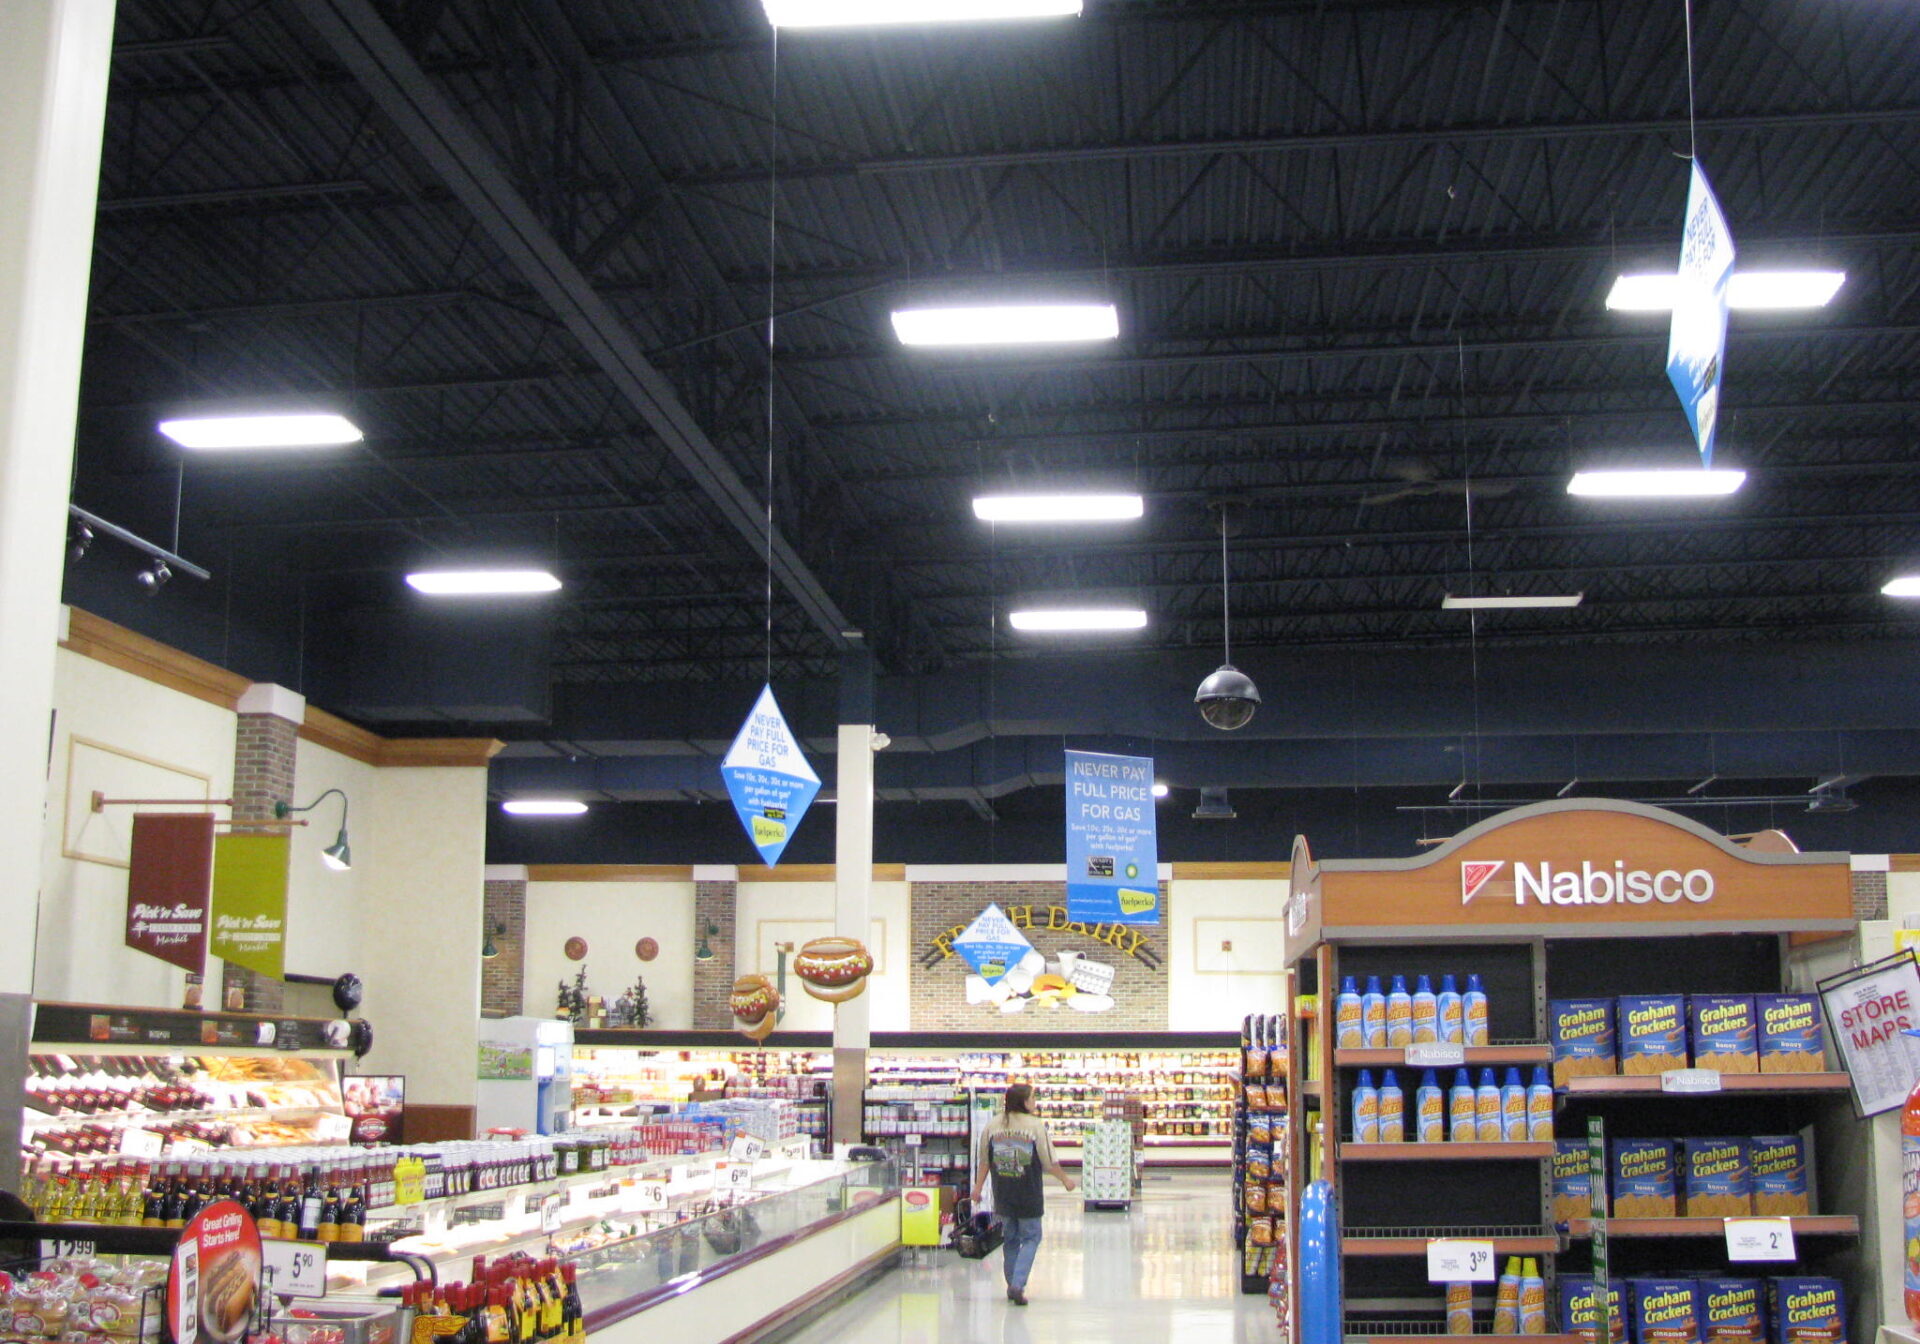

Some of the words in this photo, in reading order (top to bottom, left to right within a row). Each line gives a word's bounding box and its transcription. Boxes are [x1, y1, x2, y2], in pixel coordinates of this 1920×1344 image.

[755, 712, 781, 728] NEVER
[750, 725, 764, 738] PAY
[766, 728, 786, 743] FULL
[747, 737, 769, 752] PRICE
[772, 743, 789, 757] FOR
[759, 754, 776, 768] GAS
[1074, 761, 1118, 778] NEVER
[1122, 766, 1146, 780] PAY
[1074, 782, 1107, 798] FULL
[1110, 785, 1148, 801] PRICE
[1082, 803, 1110, 819] FOR
[1114, 806, 1141, 821] GAS
[1514, 860, 1715, 905] Nabisco
[1559, 1007, 1605, 1027] Graham
[1628, 1004, 1676, 1024] Graham
[1700, 1003, 1747, 1022] Graham
[1764, 1002, 1812, 1022] Graham
[1841, 990, 1910, 1028] STORE
[1560, 1021, 1606, 1040] Crackers
[1629, 1018, 1677, 1037] Crackers
[1701, 1017, 1748, 1036] Crackers
[1766, 1016, 1813, 1035] Crackers
[1851, 1016, 1912, 1051] MAPS
[1419, 1049, 1461, 1060] Nabisco
[1573, 1046, 1595, 1054] honey
[1644, 1043, 1665, 1051] honey
[1715, 1041, 1737, 1050] honey
[1781, 1041, 1802, 1049] honey
[1676, 1075, 1718, 1086] Nabisco
[1553, 1148, 1590, 1166] Graha
[1620, 1147, 1666, 1166] Graham
[1692, 1145, 1739, 1165] Graham
[1553, 1162, 1590, 1178] Cracke
[1621, 1160, 1666, 1178] Crackers
[1693, 1159, 1739, 1177] Crackers
[203, 1216, 222, 1232] Great
[223, 1212, 243, 1228] Grilling
[203, 1232, 225, 1248] Starts
[225, 1227, 240, 1244] Here!
[1570, 1291, 1619, 1310] Gram
[1643, 1290, 1691, 1310] Graham
[1708, 1289, 1755, 1308] Graham
[1787, 1289, 1835, 1309] Graham
[1571, 1304, 1619, 1324] Cracrs
[1645, 1304, 1692, 1324] Crackers
[1709, 1303, 1755, 1322] Crackers
[1788, 1303, 1836, 1323] Crackers
[1796, 1329, 1831, 1337] cinnamon
